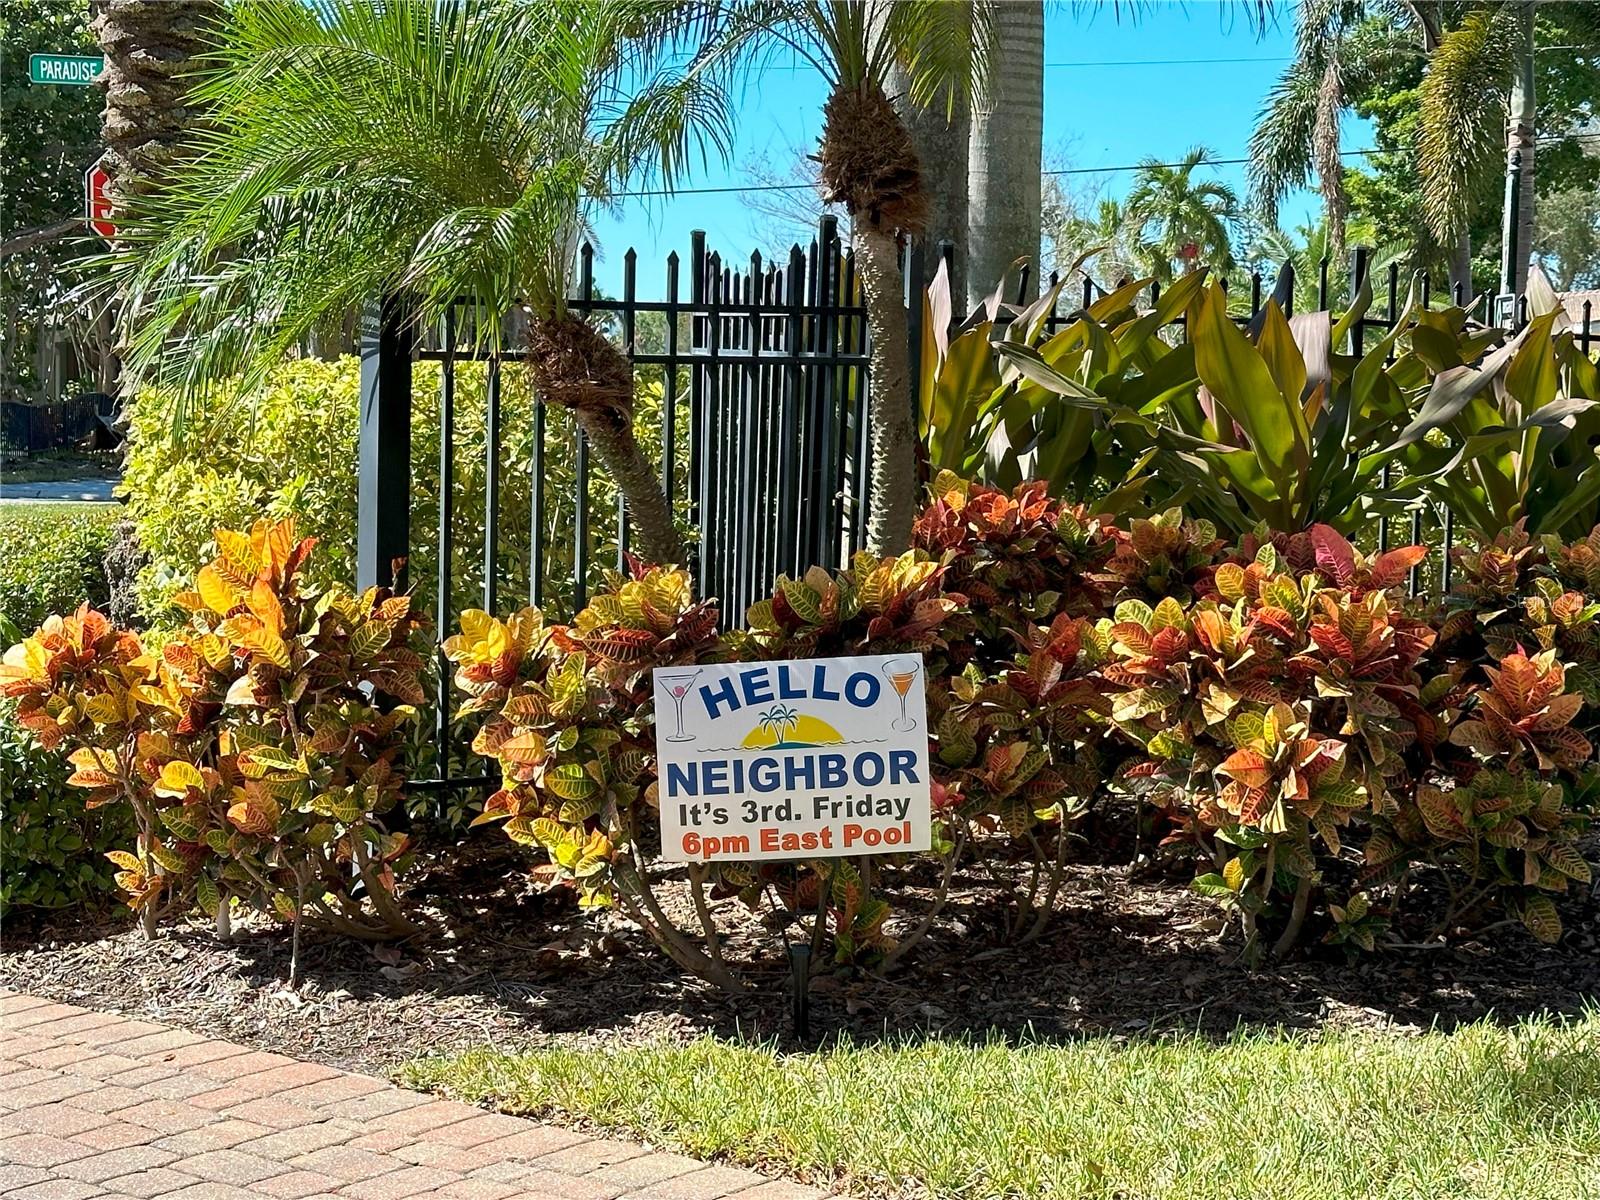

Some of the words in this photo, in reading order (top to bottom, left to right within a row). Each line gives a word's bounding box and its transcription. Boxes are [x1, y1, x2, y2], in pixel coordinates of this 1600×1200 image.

[40, 60, 97, 80] PARADISE
[699, 665, 881, 720] HELLO
[666, 750, 920, 797] NEIGHBOR
[679, 803, 729, 826] It's
[741, 798, 802, 824] 3rd.
[813, 794, 911, 821] Friday
[682, 832, 750, 859] 6pm
[760, 825, 833, 852] East
[843, 821, 912, 847] Pool
